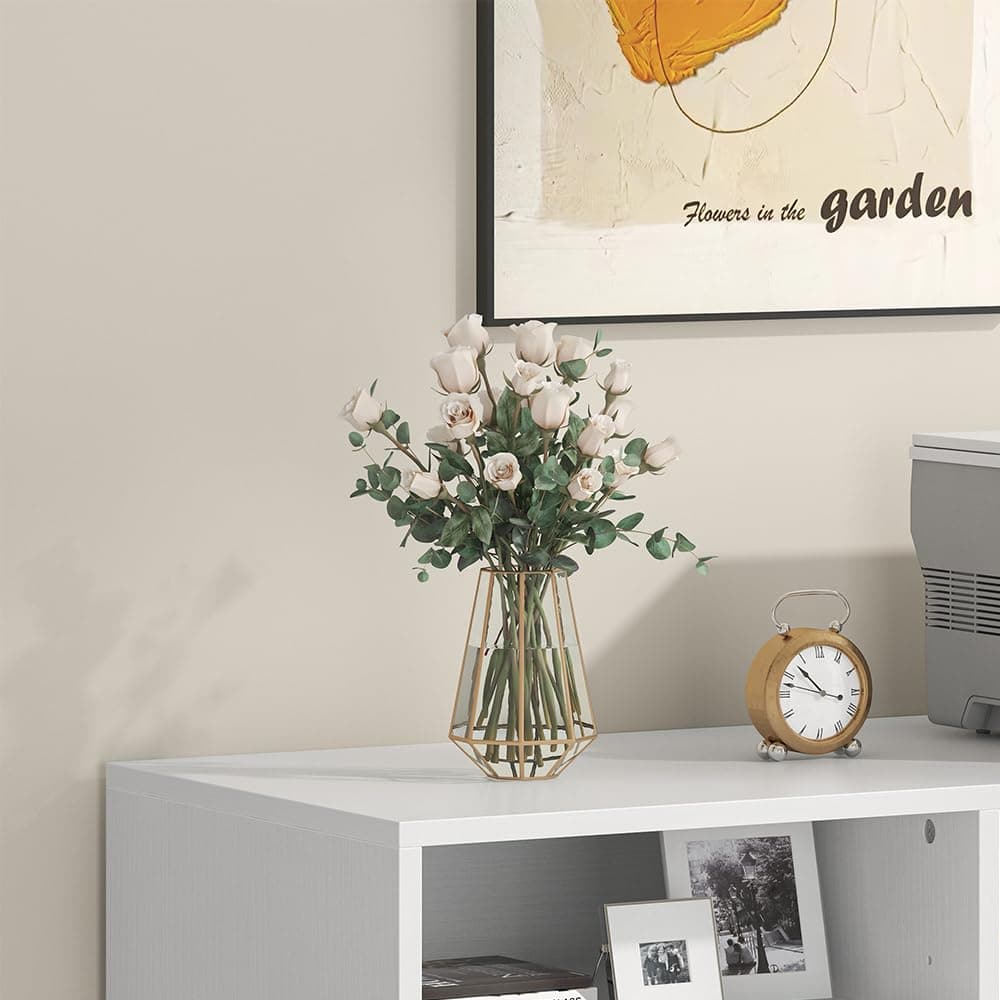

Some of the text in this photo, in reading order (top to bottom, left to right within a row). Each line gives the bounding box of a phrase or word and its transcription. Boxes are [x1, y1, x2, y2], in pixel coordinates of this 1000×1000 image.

[682, 172, 973, 233] Flowers in the garden
